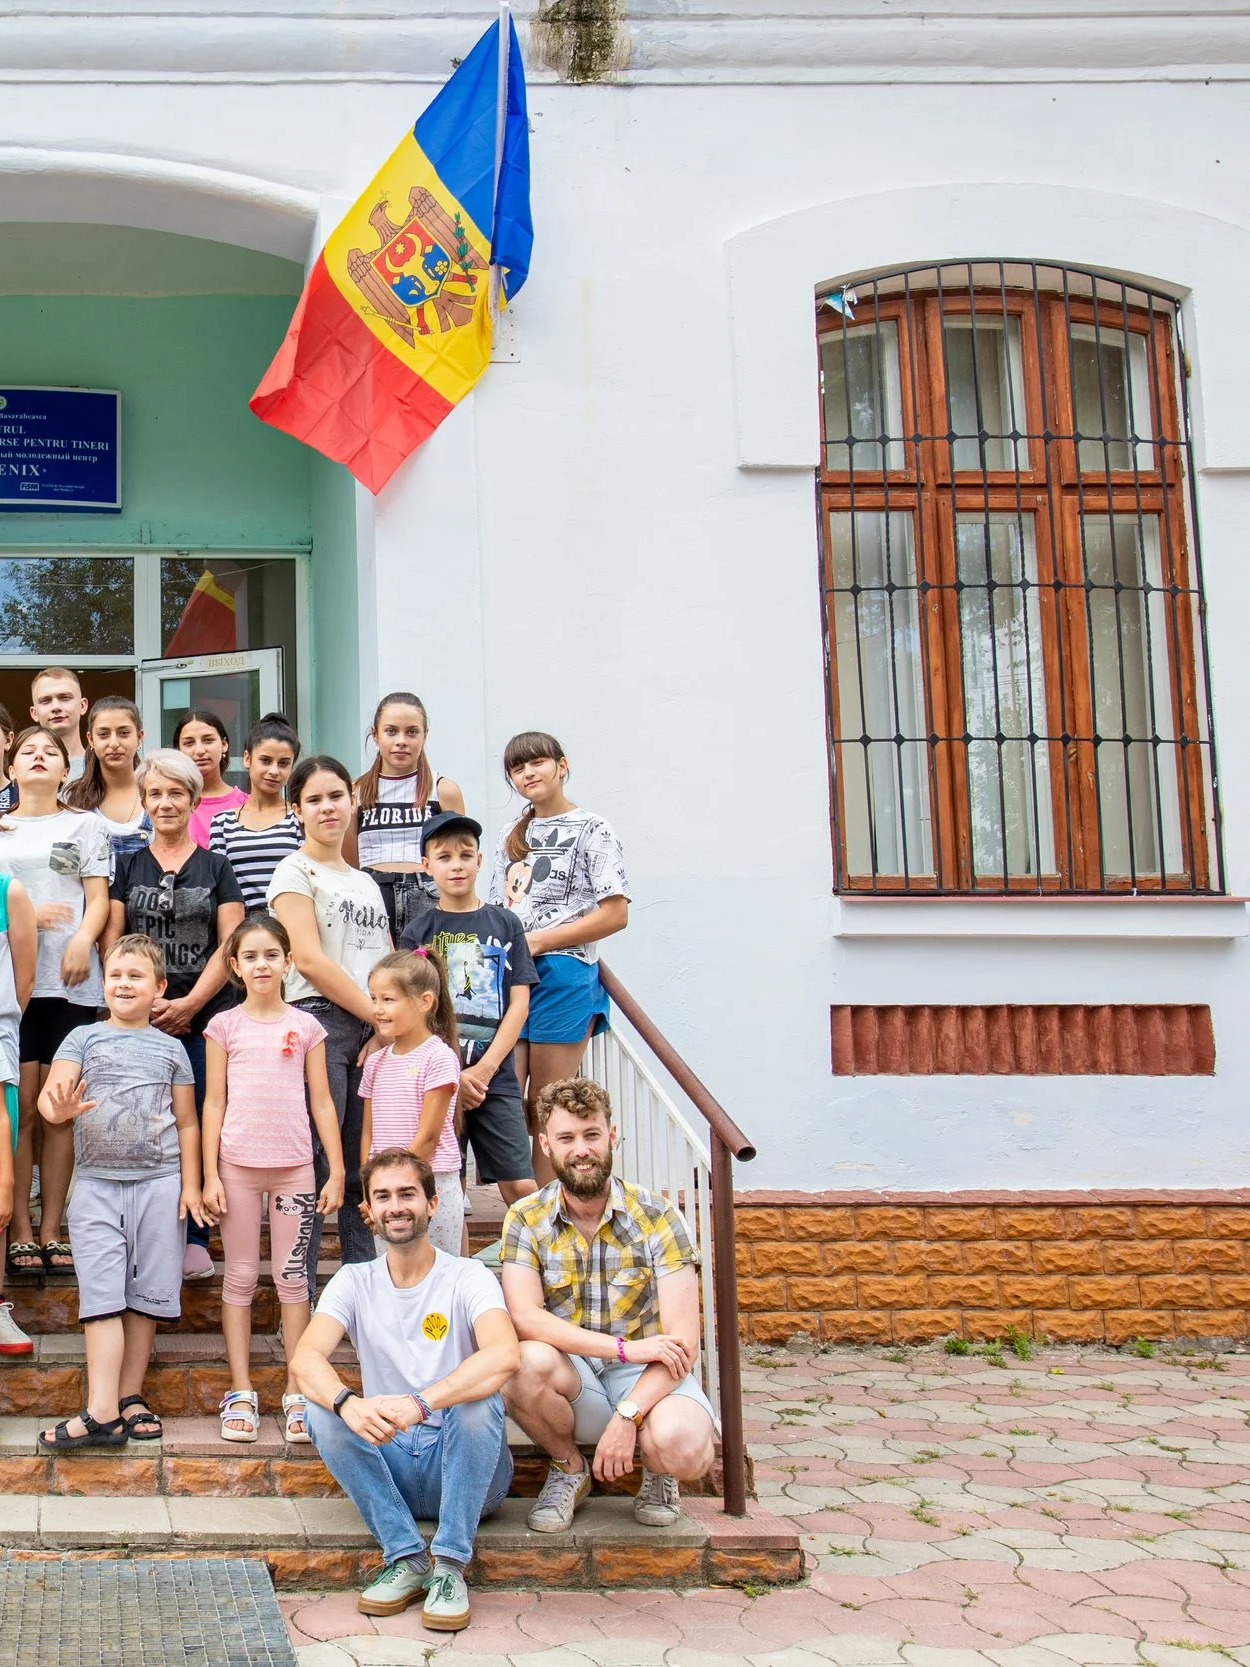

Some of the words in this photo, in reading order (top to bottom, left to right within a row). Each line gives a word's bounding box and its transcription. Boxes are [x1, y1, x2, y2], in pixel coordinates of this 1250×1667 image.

[23, 438, 68, 449] PENTRU
[71, 440, 109, 451] TINERI
[15, 452, 70, 461] молодежный
[72, 455, 98, 463] центр
[208, 656, 245, 668] ВЫХОД
[362, 805, 432, 827] FLORIDA
[135, 891, 159, 912] DO
[135, 914, 176, 939] EPIC
[281, 1192, 316, 1280] PANDASTIC
